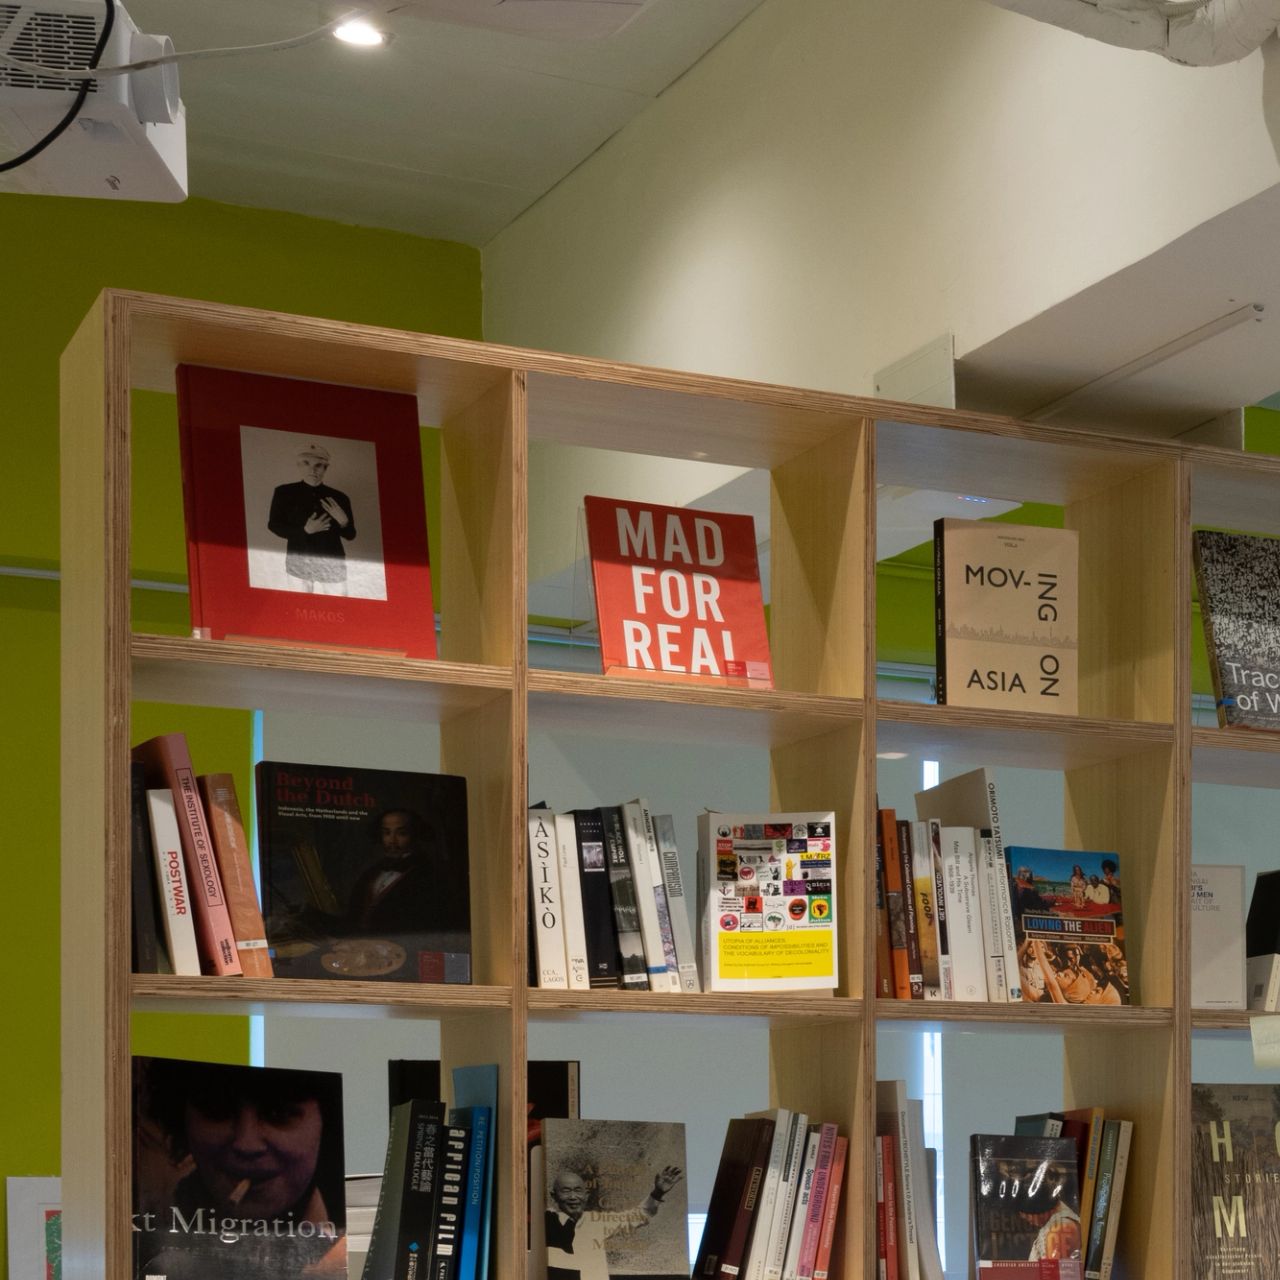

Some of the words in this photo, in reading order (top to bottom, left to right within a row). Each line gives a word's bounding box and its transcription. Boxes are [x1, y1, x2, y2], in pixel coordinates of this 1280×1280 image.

[615, 507, 724, 567] MAD
[965, 565, 1032, 588] MOV-
[632, 565, 725, 622] FOR
[1037, 573, 1059, 625] ING
[967, 669, 1027, 695] ASIA
[1039, 654, 1060, 697] ON
[1237, 693, 1260, 712] of
[181, 776, 193, 794] THE
[276, 771, 354, 792] Beyond
[276, 788, 309, 804] the
[316, 790, 376, 808] Dutch
[987, 783, 998, 823] ORIMOTO
[184, 795, 202, 837] INSTITUTE
[196, 839, 206, 851] OF
[615, 824, 623, 844] BLACK
[991, 826, 1003, 860] TATSUMI
[618, 845, 626, 863] HOLE
[167, 851, 187, 915] POSTWAR
[200, 853, 217, 898] SEXOLOGY
[663, 851, 683, 897] COMPARISON
[998, 863, 1010, 914] Performance
[920, 892, 932, 920] FOOD
[1026, 919, 1062, 930] LOVING
[1063, 920, 1082, 932] THE
[1085, 922, 1112, 934] ALIEN
[822, 1126, 835, 1149] NOTES
[820, 1150, 832, 1169] FROM
[803, 1168, 814, 1191] Speech
[801, 1192, 810, 1205] acts
[810, 1171, 827, 1223] UNDERGROUND
[169, 1206, 338, 1244] Migration
